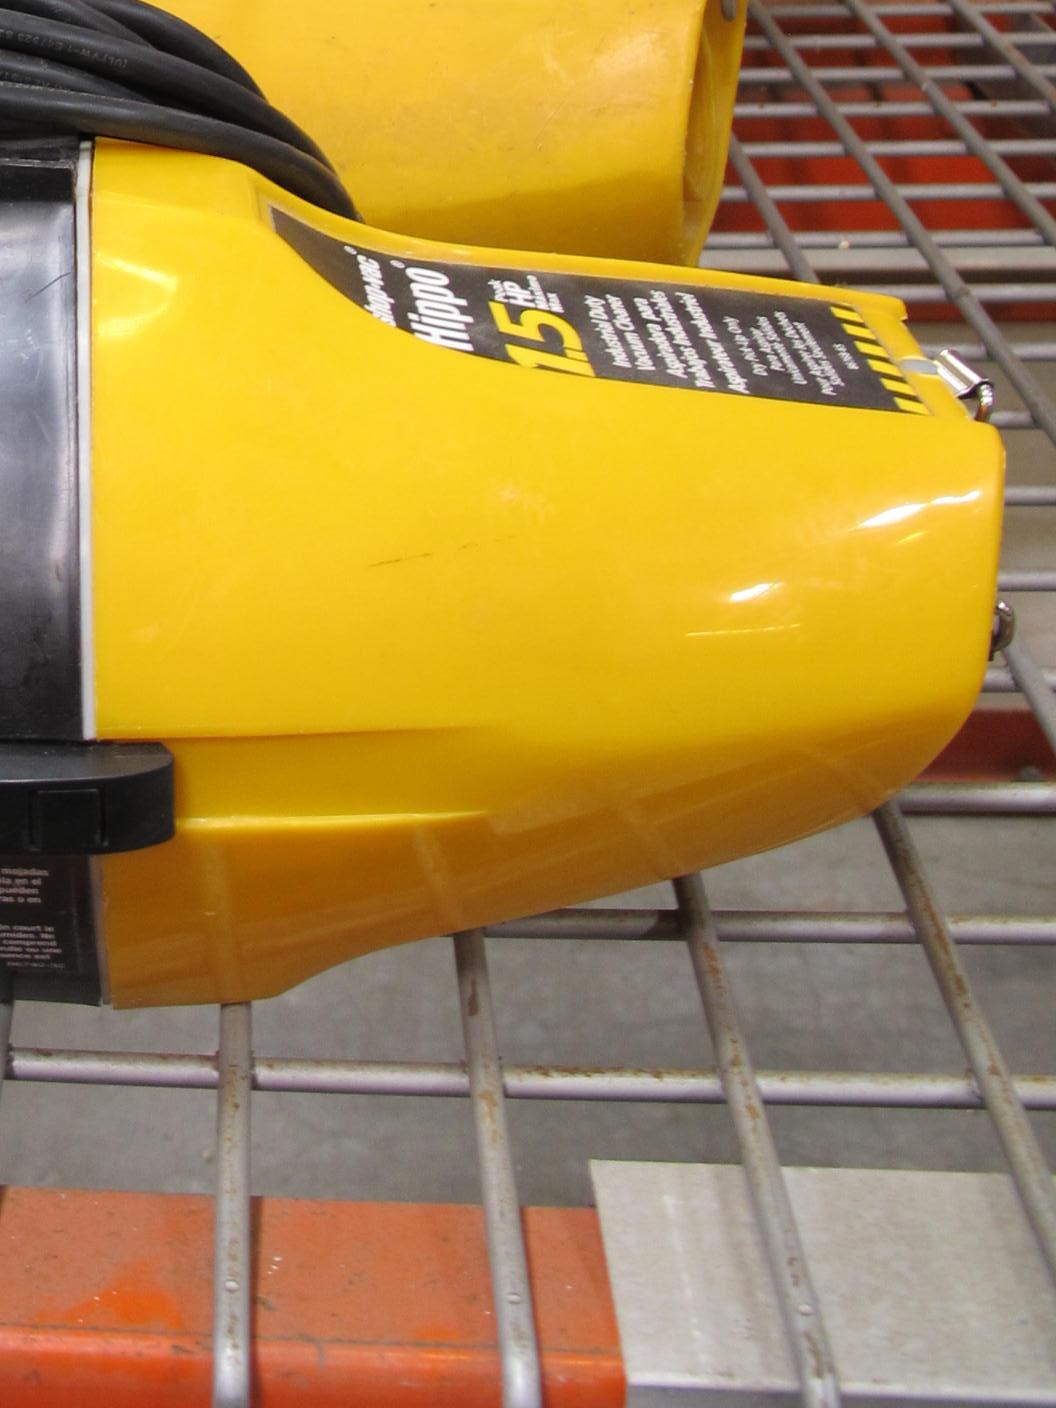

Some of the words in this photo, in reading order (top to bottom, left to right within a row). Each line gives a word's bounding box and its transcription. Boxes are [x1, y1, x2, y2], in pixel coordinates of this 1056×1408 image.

[405, 266, 475, 352] Hippo
[503, 280, 536, 307] HP
[584, 294, 608, 325] Duty
[605, 293, 634, 334] Cleaner
[633, 297, 661, 323] para
[487, 298, 596, 378] 1.5
[650, 290, 688, 344] Industriales
[675, 292, 716, 341] Industriel
[596, 324, 632, 368] Industrial
[624, 334, 656, 371] Vacuum
[648, 327, 688, 378] Aspiradora
[679, 344, 716, 388] Trabajos
[709, 341, 750, 394] Aspirateur
